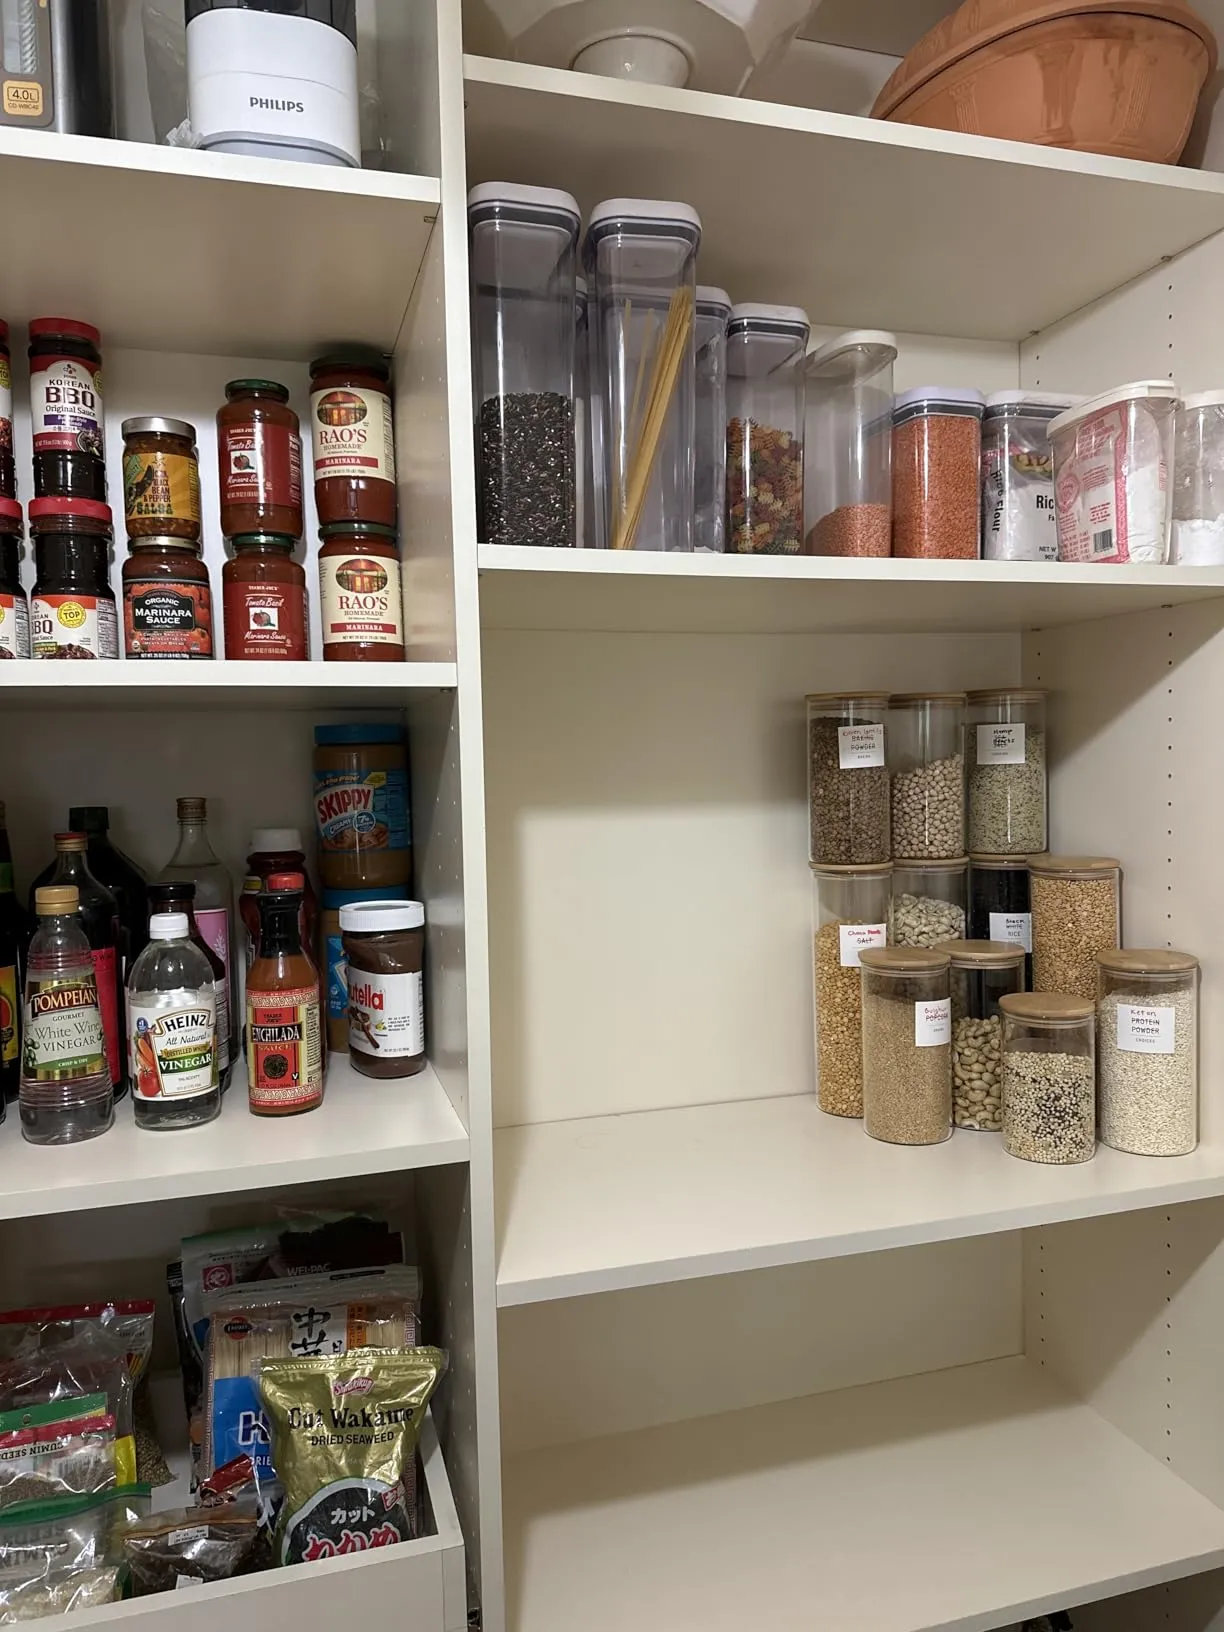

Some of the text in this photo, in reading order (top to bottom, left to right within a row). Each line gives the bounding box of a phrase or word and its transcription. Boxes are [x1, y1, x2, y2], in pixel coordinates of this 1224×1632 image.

[12, 90, 36, 100] 4.0L
[249, 96, 304, 113] PHILIPS
[49, 380, 90, 390] KOREAN
[46, 386, 95, 411] BBQ
[46, 405, 96, 416] Original Sauce
[320, 428, 367, 446] RAO'S
[149, 494, 171, 502] PEPPER
[1036, 495, 1054, 510] Ric
[136, 502, 173, 515] SALSA
[992, 499, 1004, 533] Flour
[145, 597, 179, 606] ORGANIC
[246, 597, 284, 607] Tomato Basil
[338, 595, 388, 610] RAO'S
[63, 612, 80, 620] TOP
[135, 608, 192, 617] MARINARA
[146, 616, 180, 624] SAUCE
[270, 632, 286, 640] Sauce
[317, 789, 371, 824] SKIPPY
[34, 988, 97, 1013] POMPEIAN
[350, 984, 384, 1010] utella
[52, 1012, 84, 1022] GOURMET
[165, 1015, 206, 1032] HEINZ
[34, 1021, 100, 1040] White Wine
[253, 1025, 300, 1041] ENCHILADA
[1132, 1026, 1160, 1034] POWDER
[43, 1036, 97, 1052] VINEGAR
[166, 1032, 208, 1046] All Natural
[166, 1047, 192, 1057] DISTILLED
[160, 1054, 211, 1070] VINEGAR
[288, 1407, 414, 1430] Cut Wakame
[312, 1431, 394, 1446] DRIED SEAWEED
[0, 1442, 64, 1460] CUMIN SEED
[331, 1507, 375, 1524] カット
